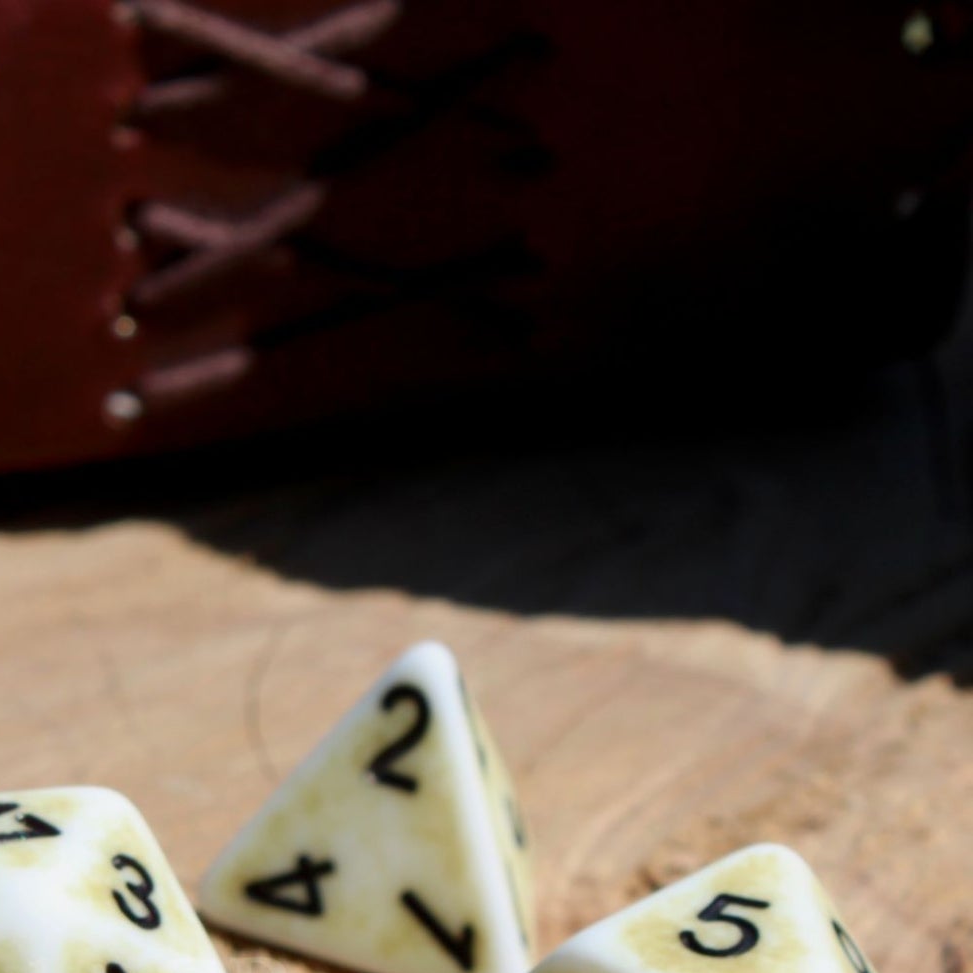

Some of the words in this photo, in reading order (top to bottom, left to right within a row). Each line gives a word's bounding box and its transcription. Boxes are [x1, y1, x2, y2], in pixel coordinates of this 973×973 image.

[366, 683, 431, 795] 2
[112, 855, 160, 930] 3
[242, 854, 335, 918] 4
[400, 890, 477, 973] 1
[679, 893, 769, 958] 5
